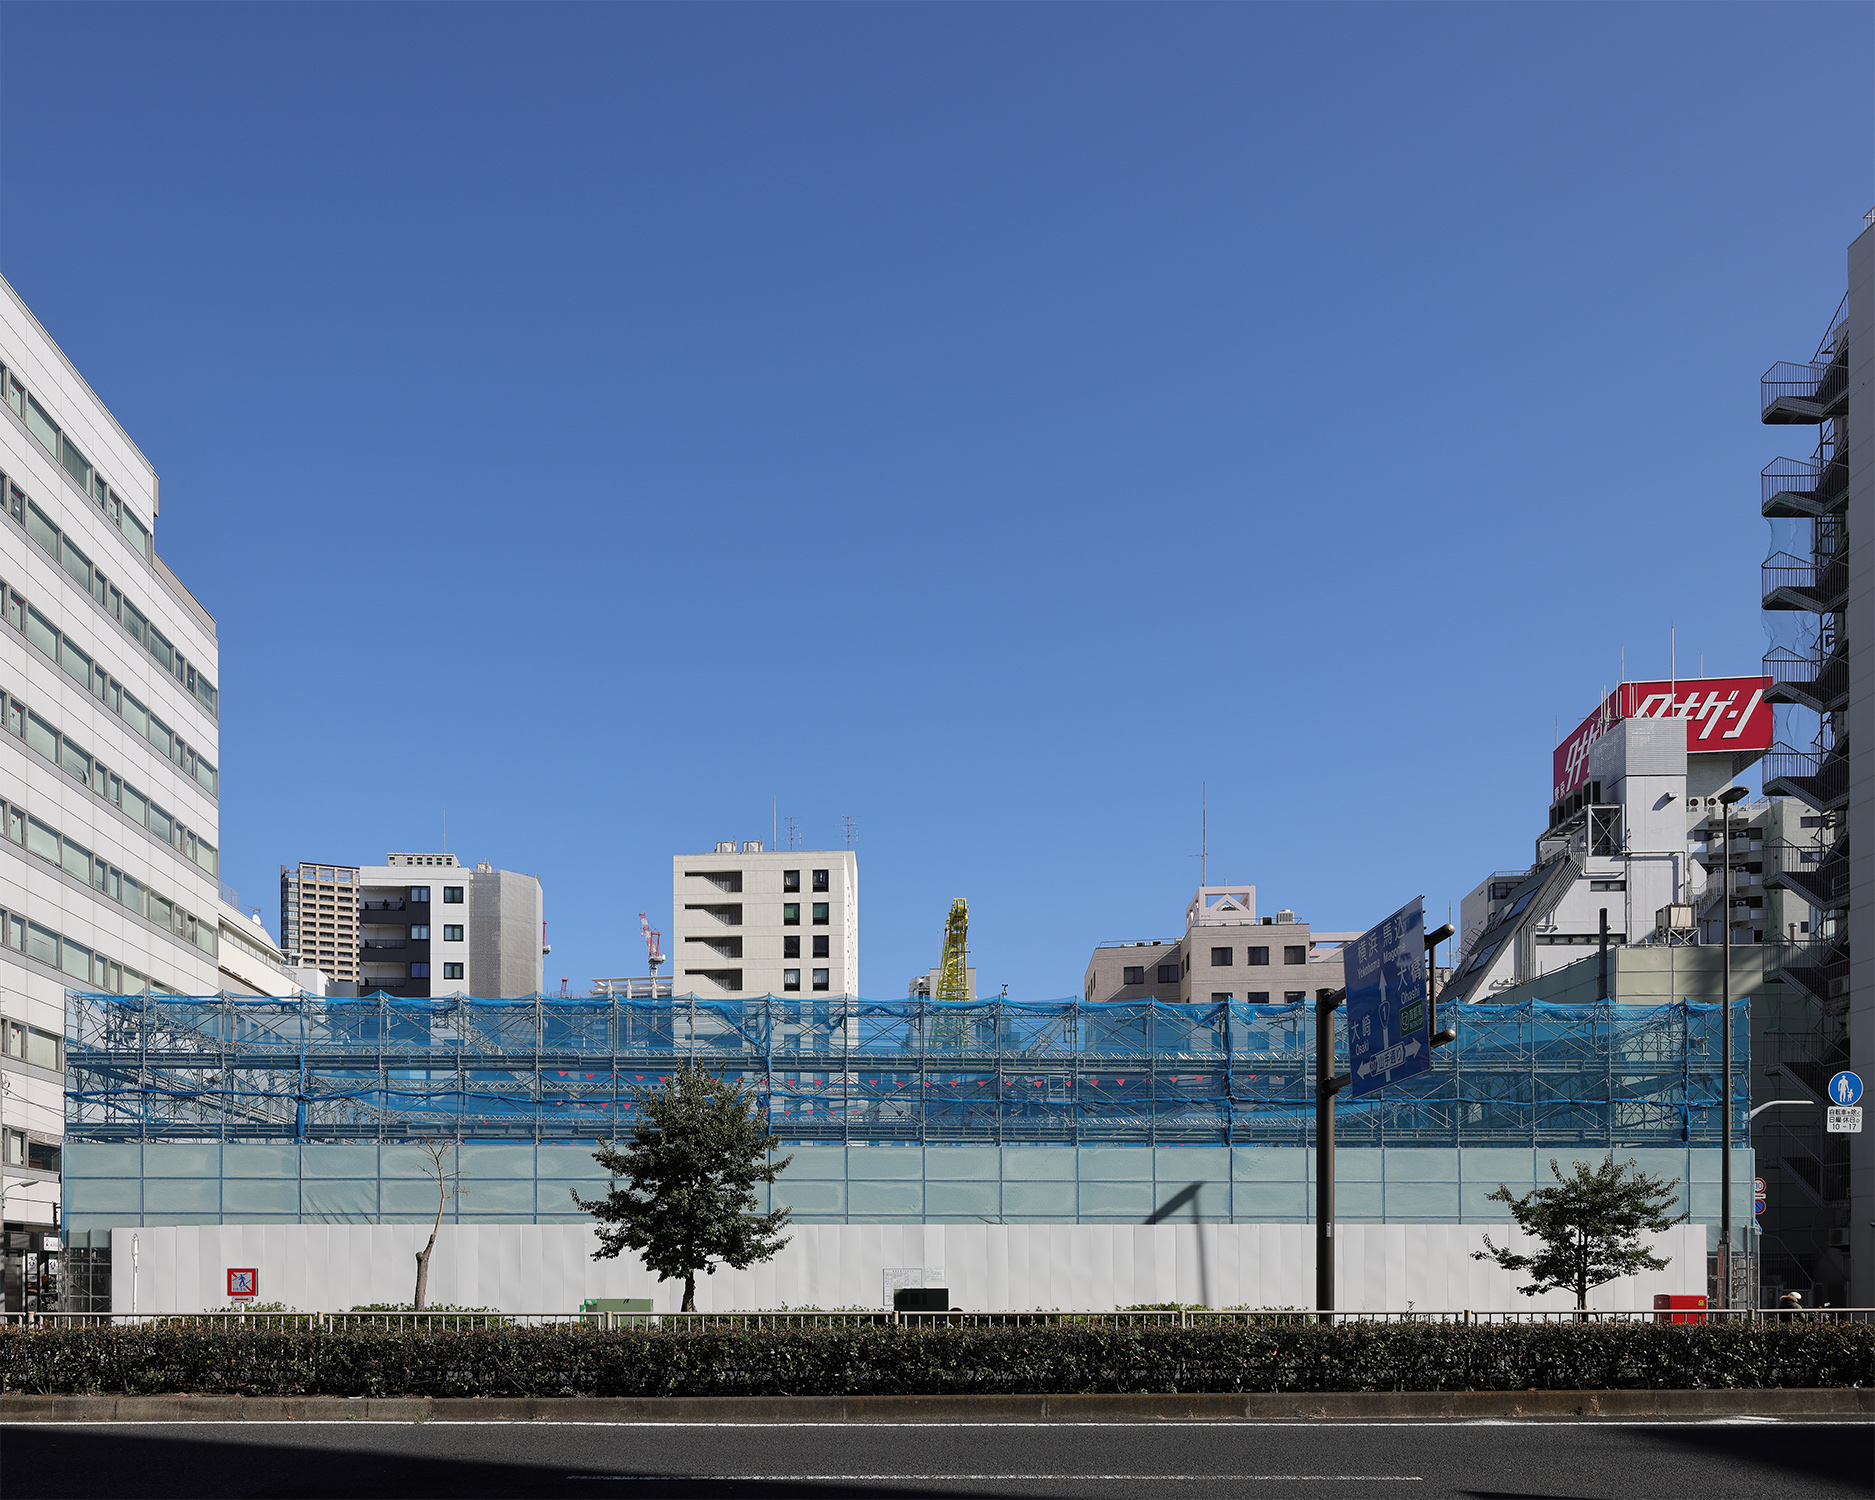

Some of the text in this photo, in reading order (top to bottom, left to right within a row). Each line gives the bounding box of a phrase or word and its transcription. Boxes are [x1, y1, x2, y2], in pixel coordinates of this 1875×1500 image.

[1357, 915, 1406, 964] 横浜 馬込
[1357, 942, 1406, 980] Yokohama Magome
[1396, 956, 1422, 991] 大橋
[1400, 984, 1420, 1005] Ohashi
[1382, 1005, 1387, 1021] 1
[1350, 1013, 1371, 1043] 大崎
[1355, 1039, 1369, 1056] Osaki
[1377, 1047, 1402, 1070] 山手通り
[1829, 1108, 1861, 1117] 自転車を除く
